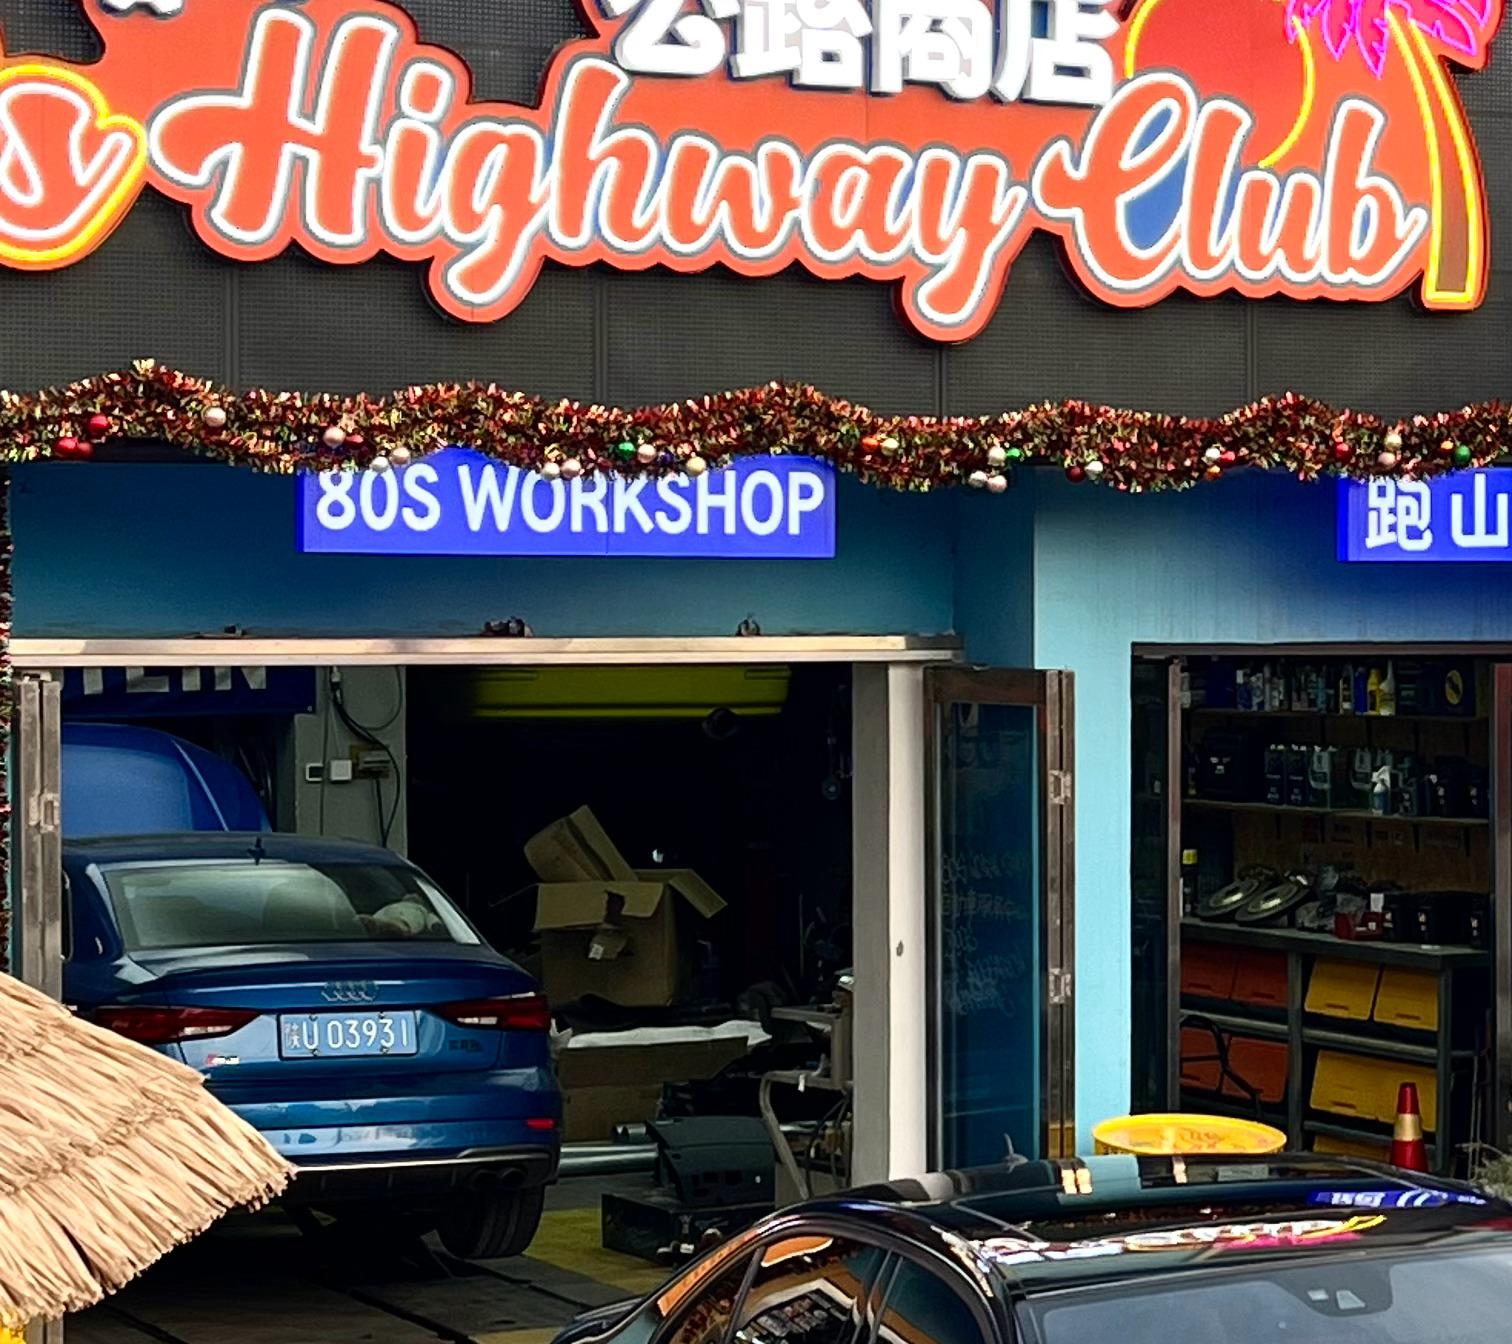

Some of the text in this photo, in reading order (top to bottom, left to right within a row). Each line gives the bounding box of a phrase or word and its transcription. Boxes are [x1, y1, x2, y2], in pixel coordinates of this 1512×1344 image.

[148, 8, 1027, 324] Highway
[1032, 71, 1428, 288] Club
[459, 462, 825, 536] WORKSHOP
[327, 1018, 409, 1049] 03931
